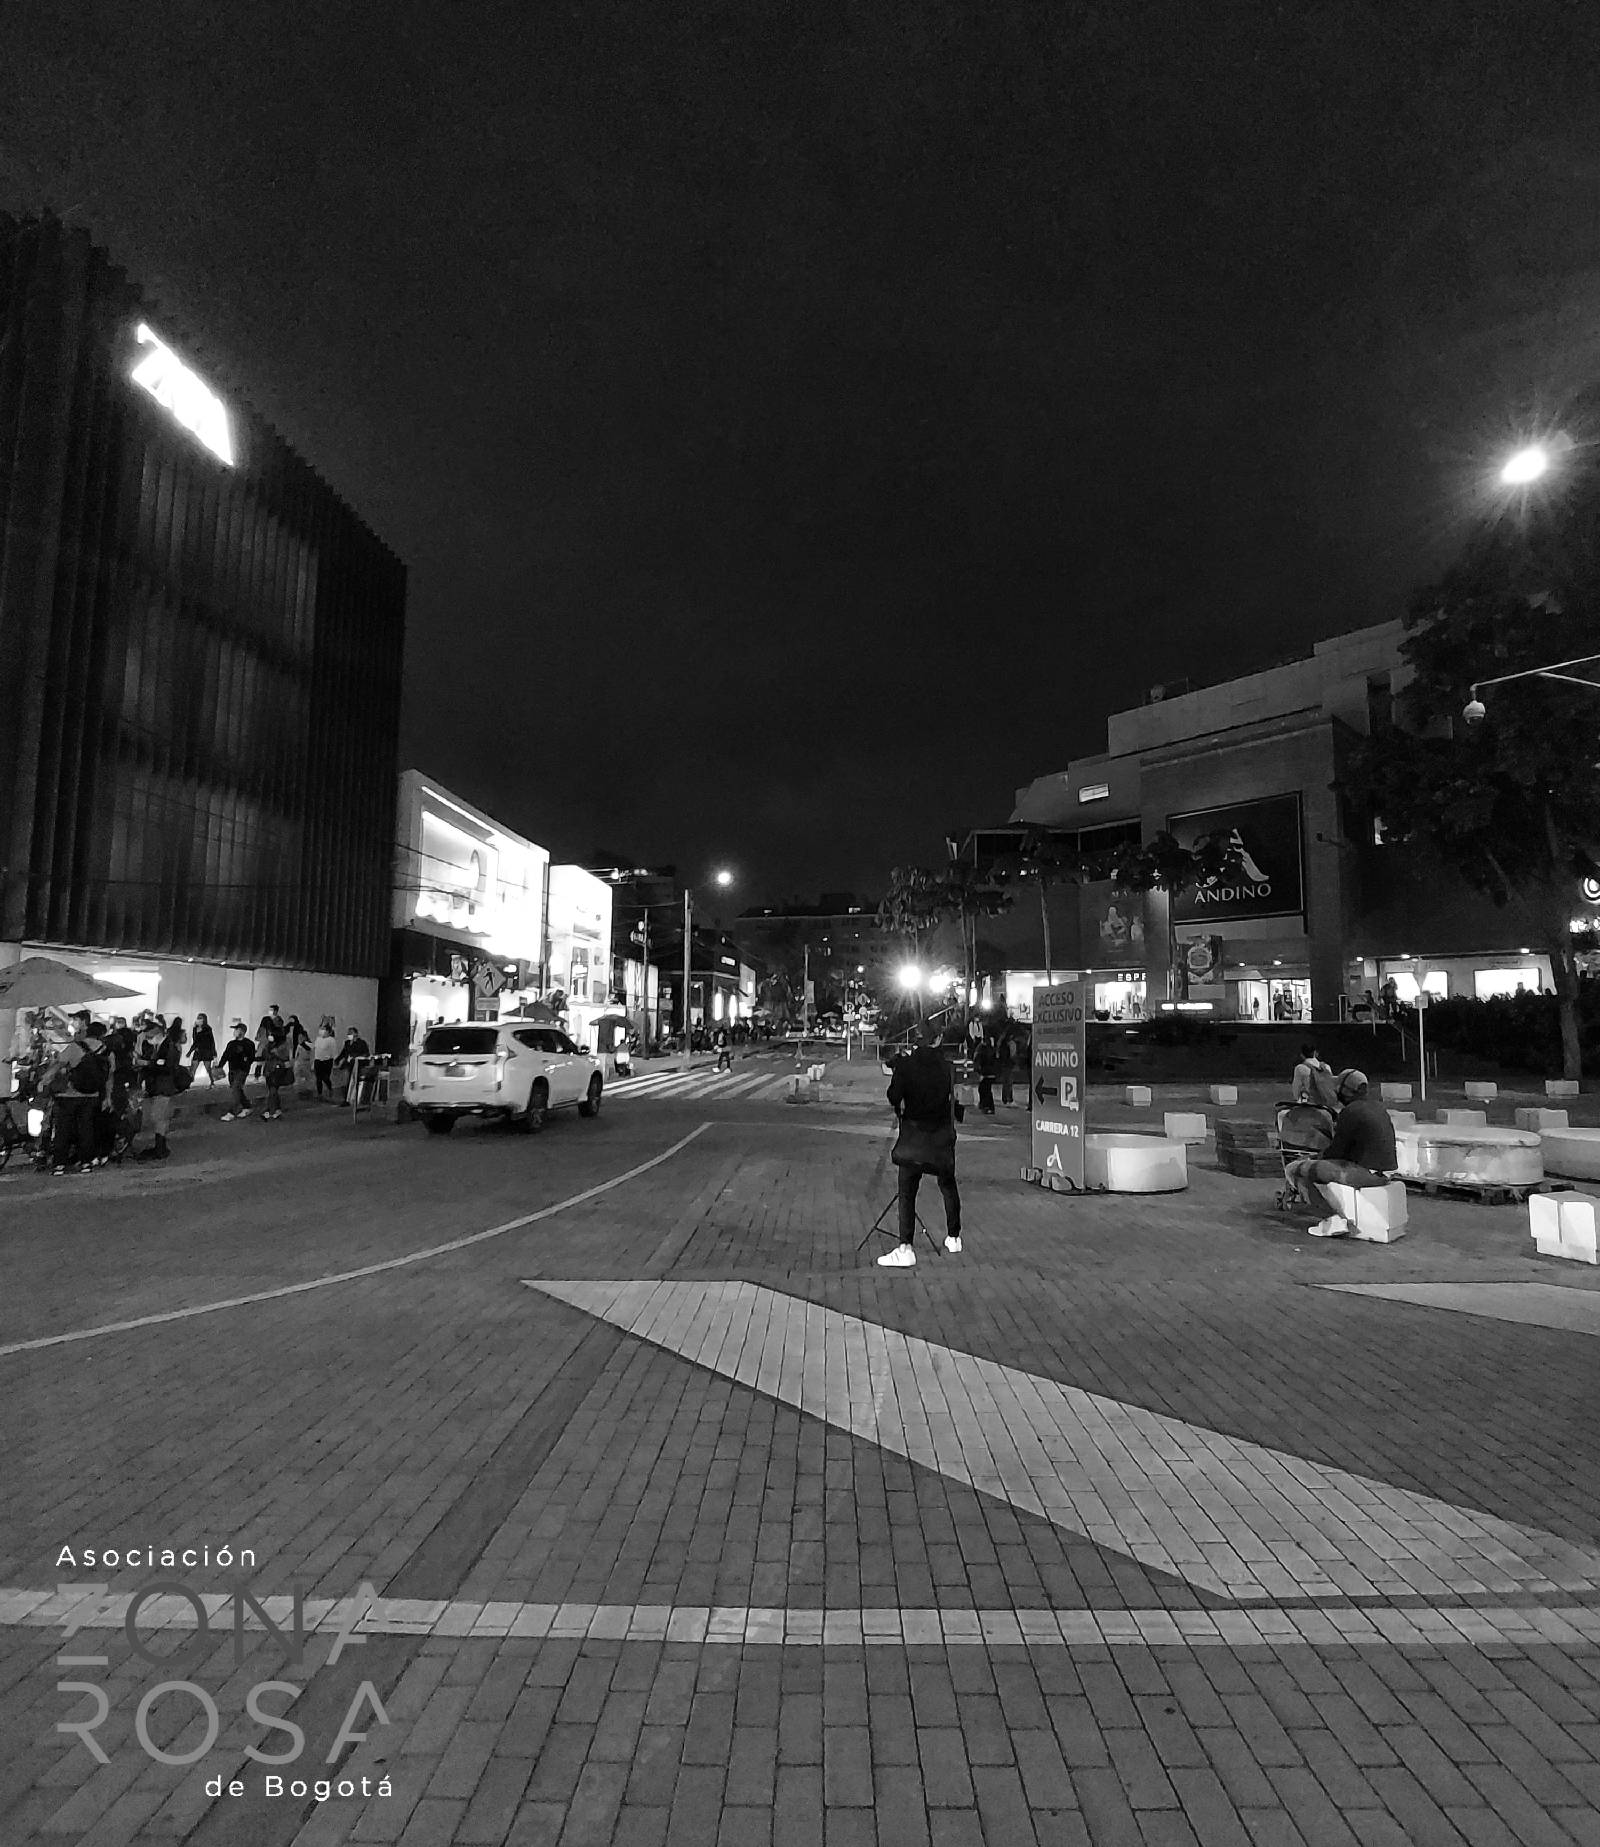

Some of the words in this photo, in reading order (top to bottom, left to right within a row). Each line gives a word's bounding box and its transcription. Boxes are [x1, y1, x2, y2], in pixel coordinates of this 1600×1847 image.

[1194, 883, 1272, 904] ANDINO
[1038, 991, 1075, 1007] ACCESO
[1033, 1007, 1082, 1024] EXCLUSIVO
[1034, 1051, 1079, 1068] ANDINO
[1065, 1082, 1074, 1101] P
[1035, 1119, 1069, 1136] CARRERA
[1070, 1125, 1079, 1138] 12
